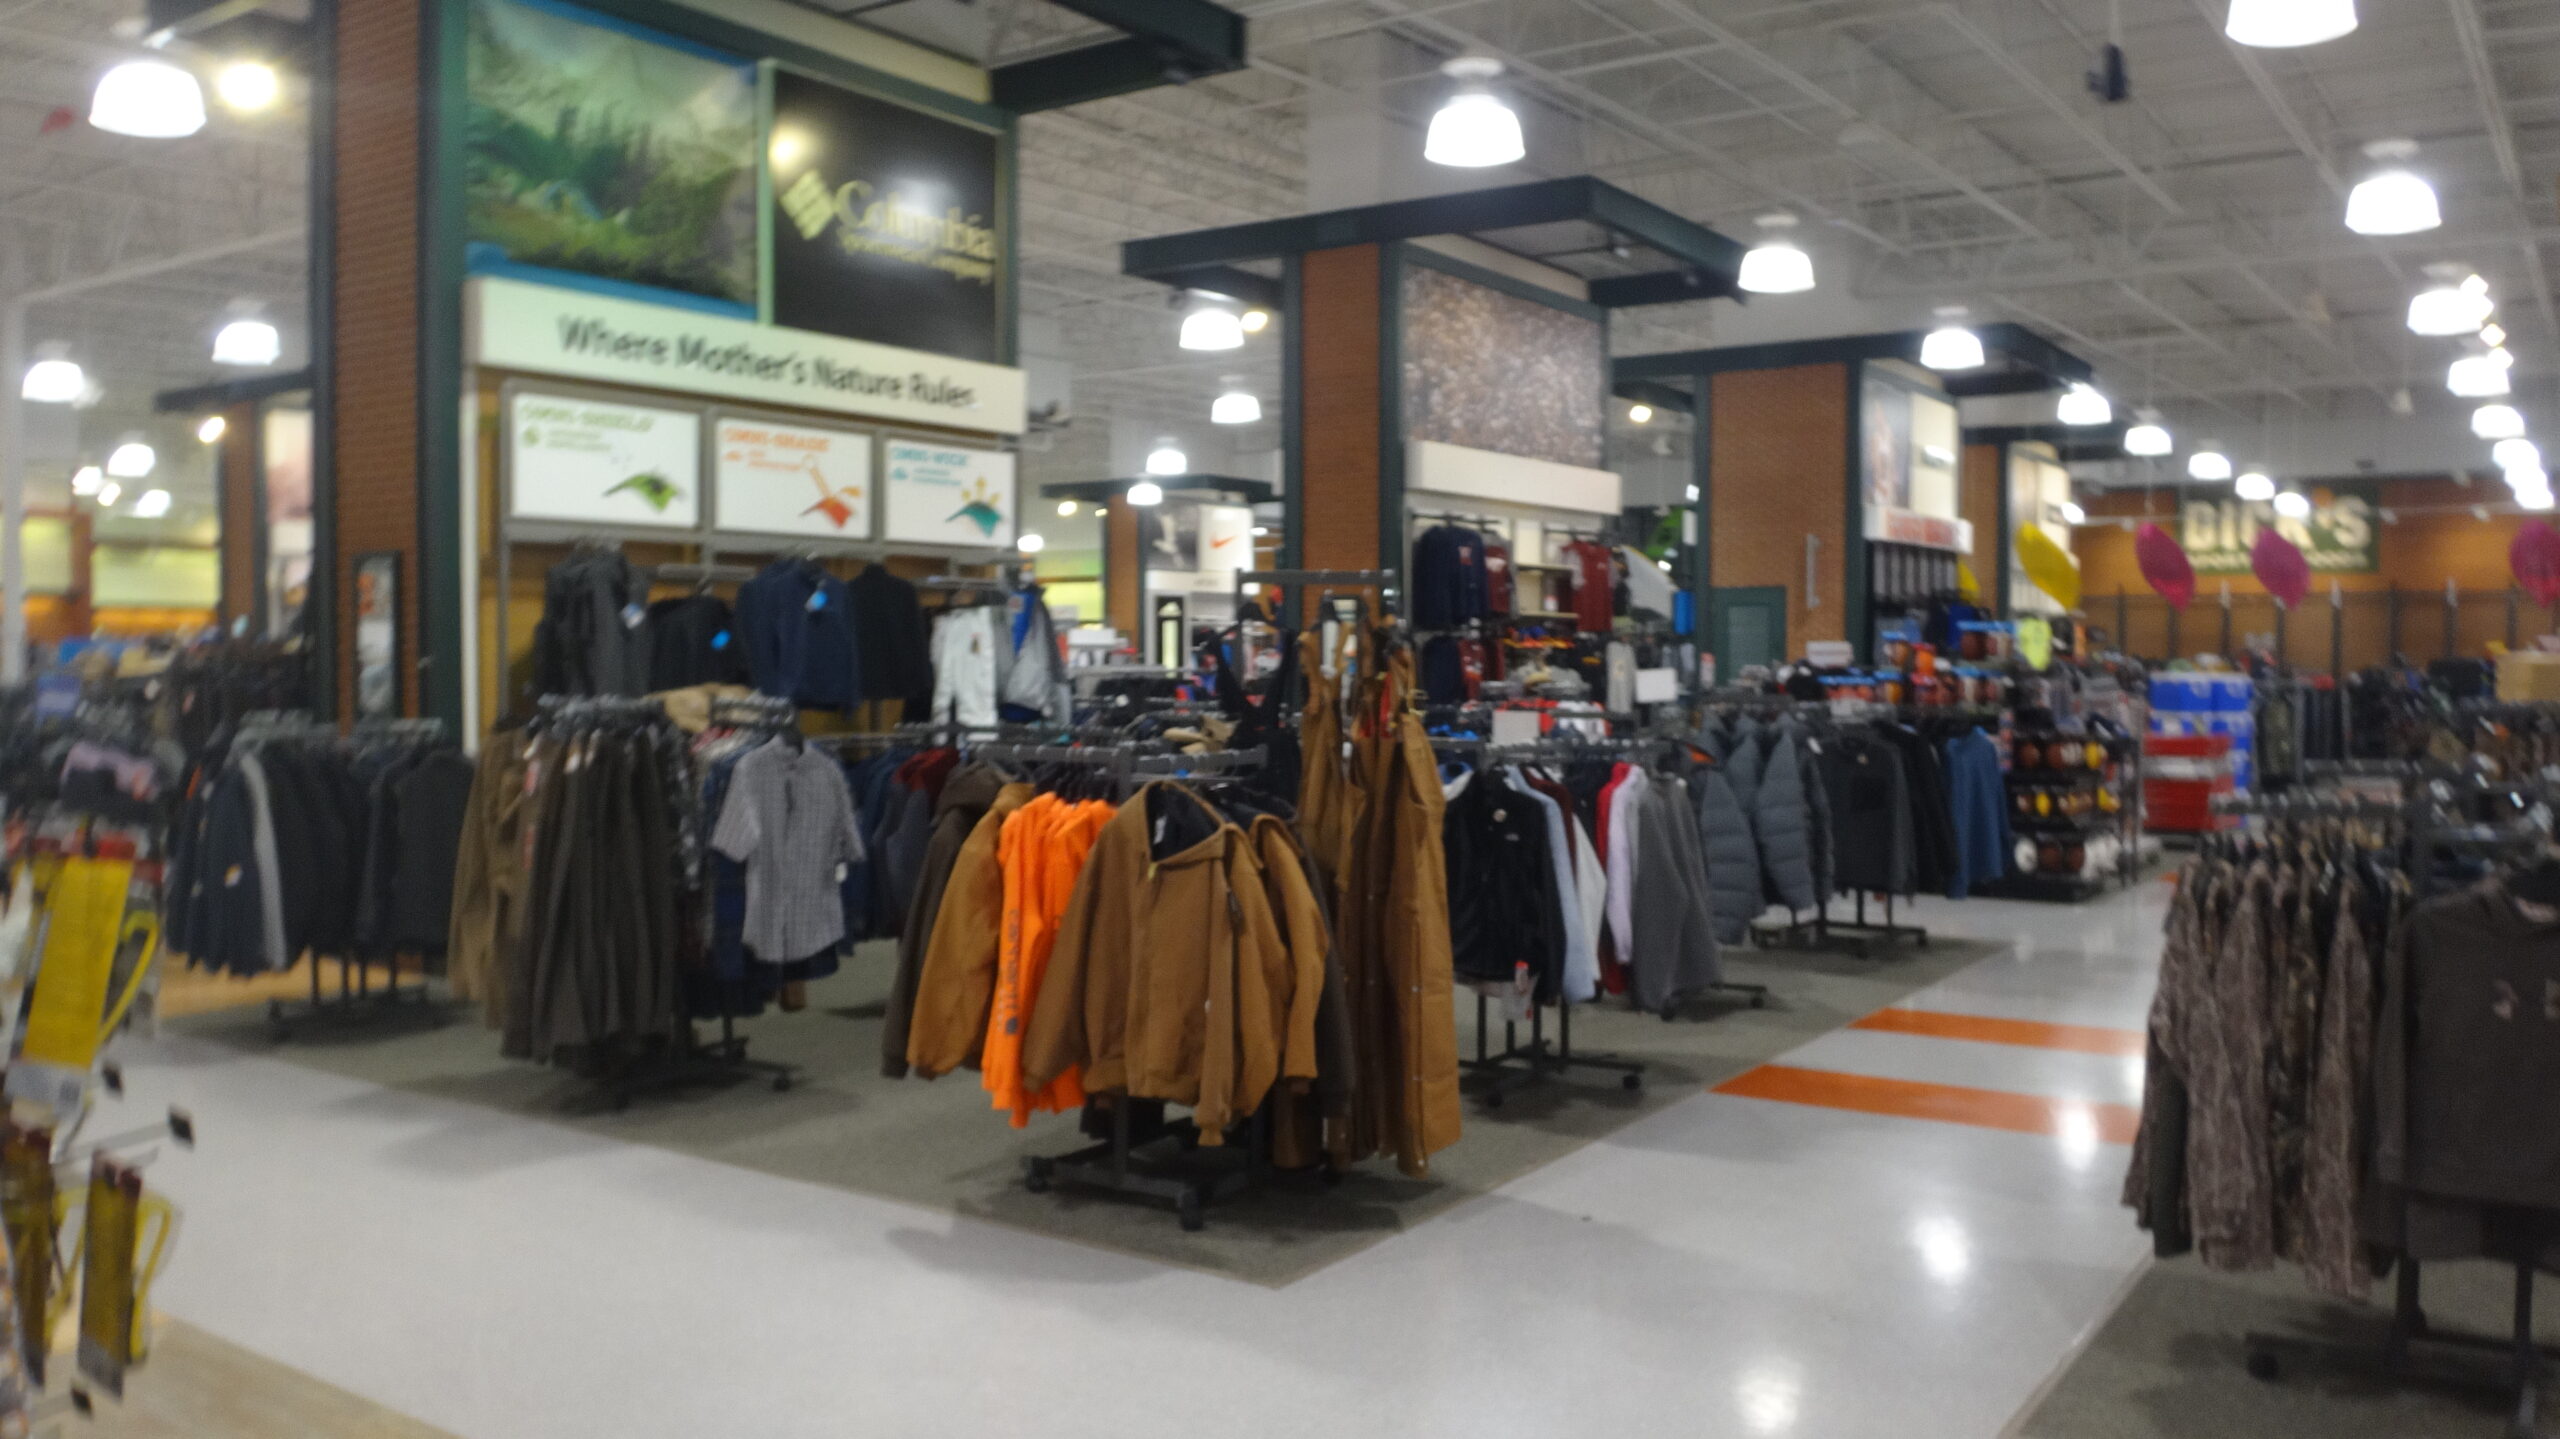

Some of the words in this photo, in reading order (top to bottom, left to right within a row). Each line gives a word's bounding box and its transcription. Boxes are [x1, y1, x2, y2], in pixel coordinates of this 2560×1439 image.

[557, 314, 669, 364] Where
[675, 331, 806, 385] Mother's
[812, 355, 901, 400] Nature
[907, 373, 978, 409] Rules
